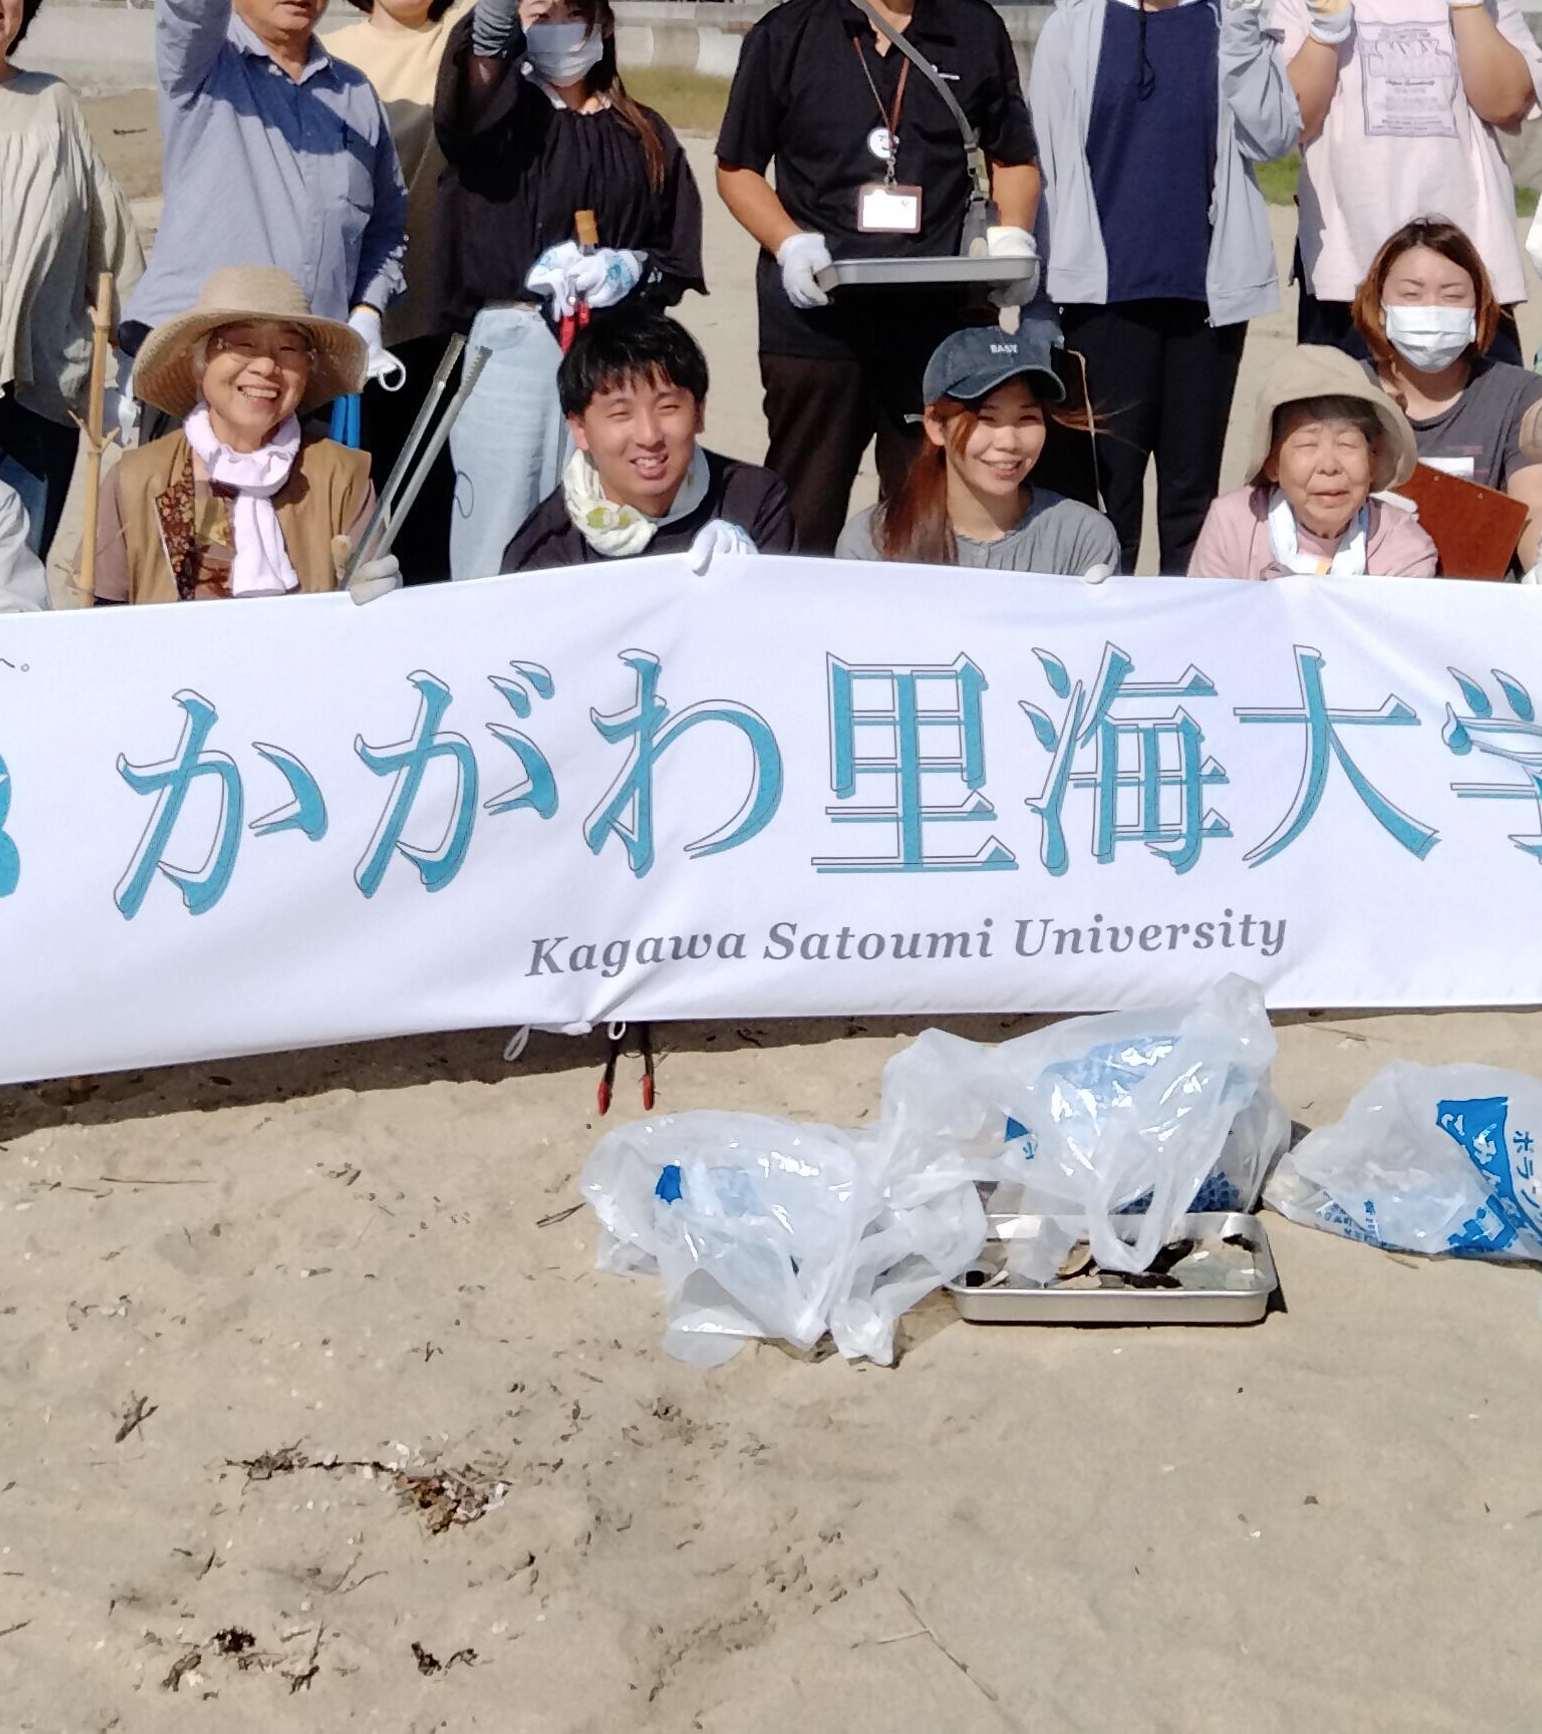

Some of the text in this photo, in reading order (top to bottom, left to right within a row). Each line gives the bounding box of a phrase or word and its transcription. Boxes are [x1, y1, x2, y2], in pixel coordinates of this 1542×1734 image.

[523, 908, 1288, 978] Kagawa Satoumi University
